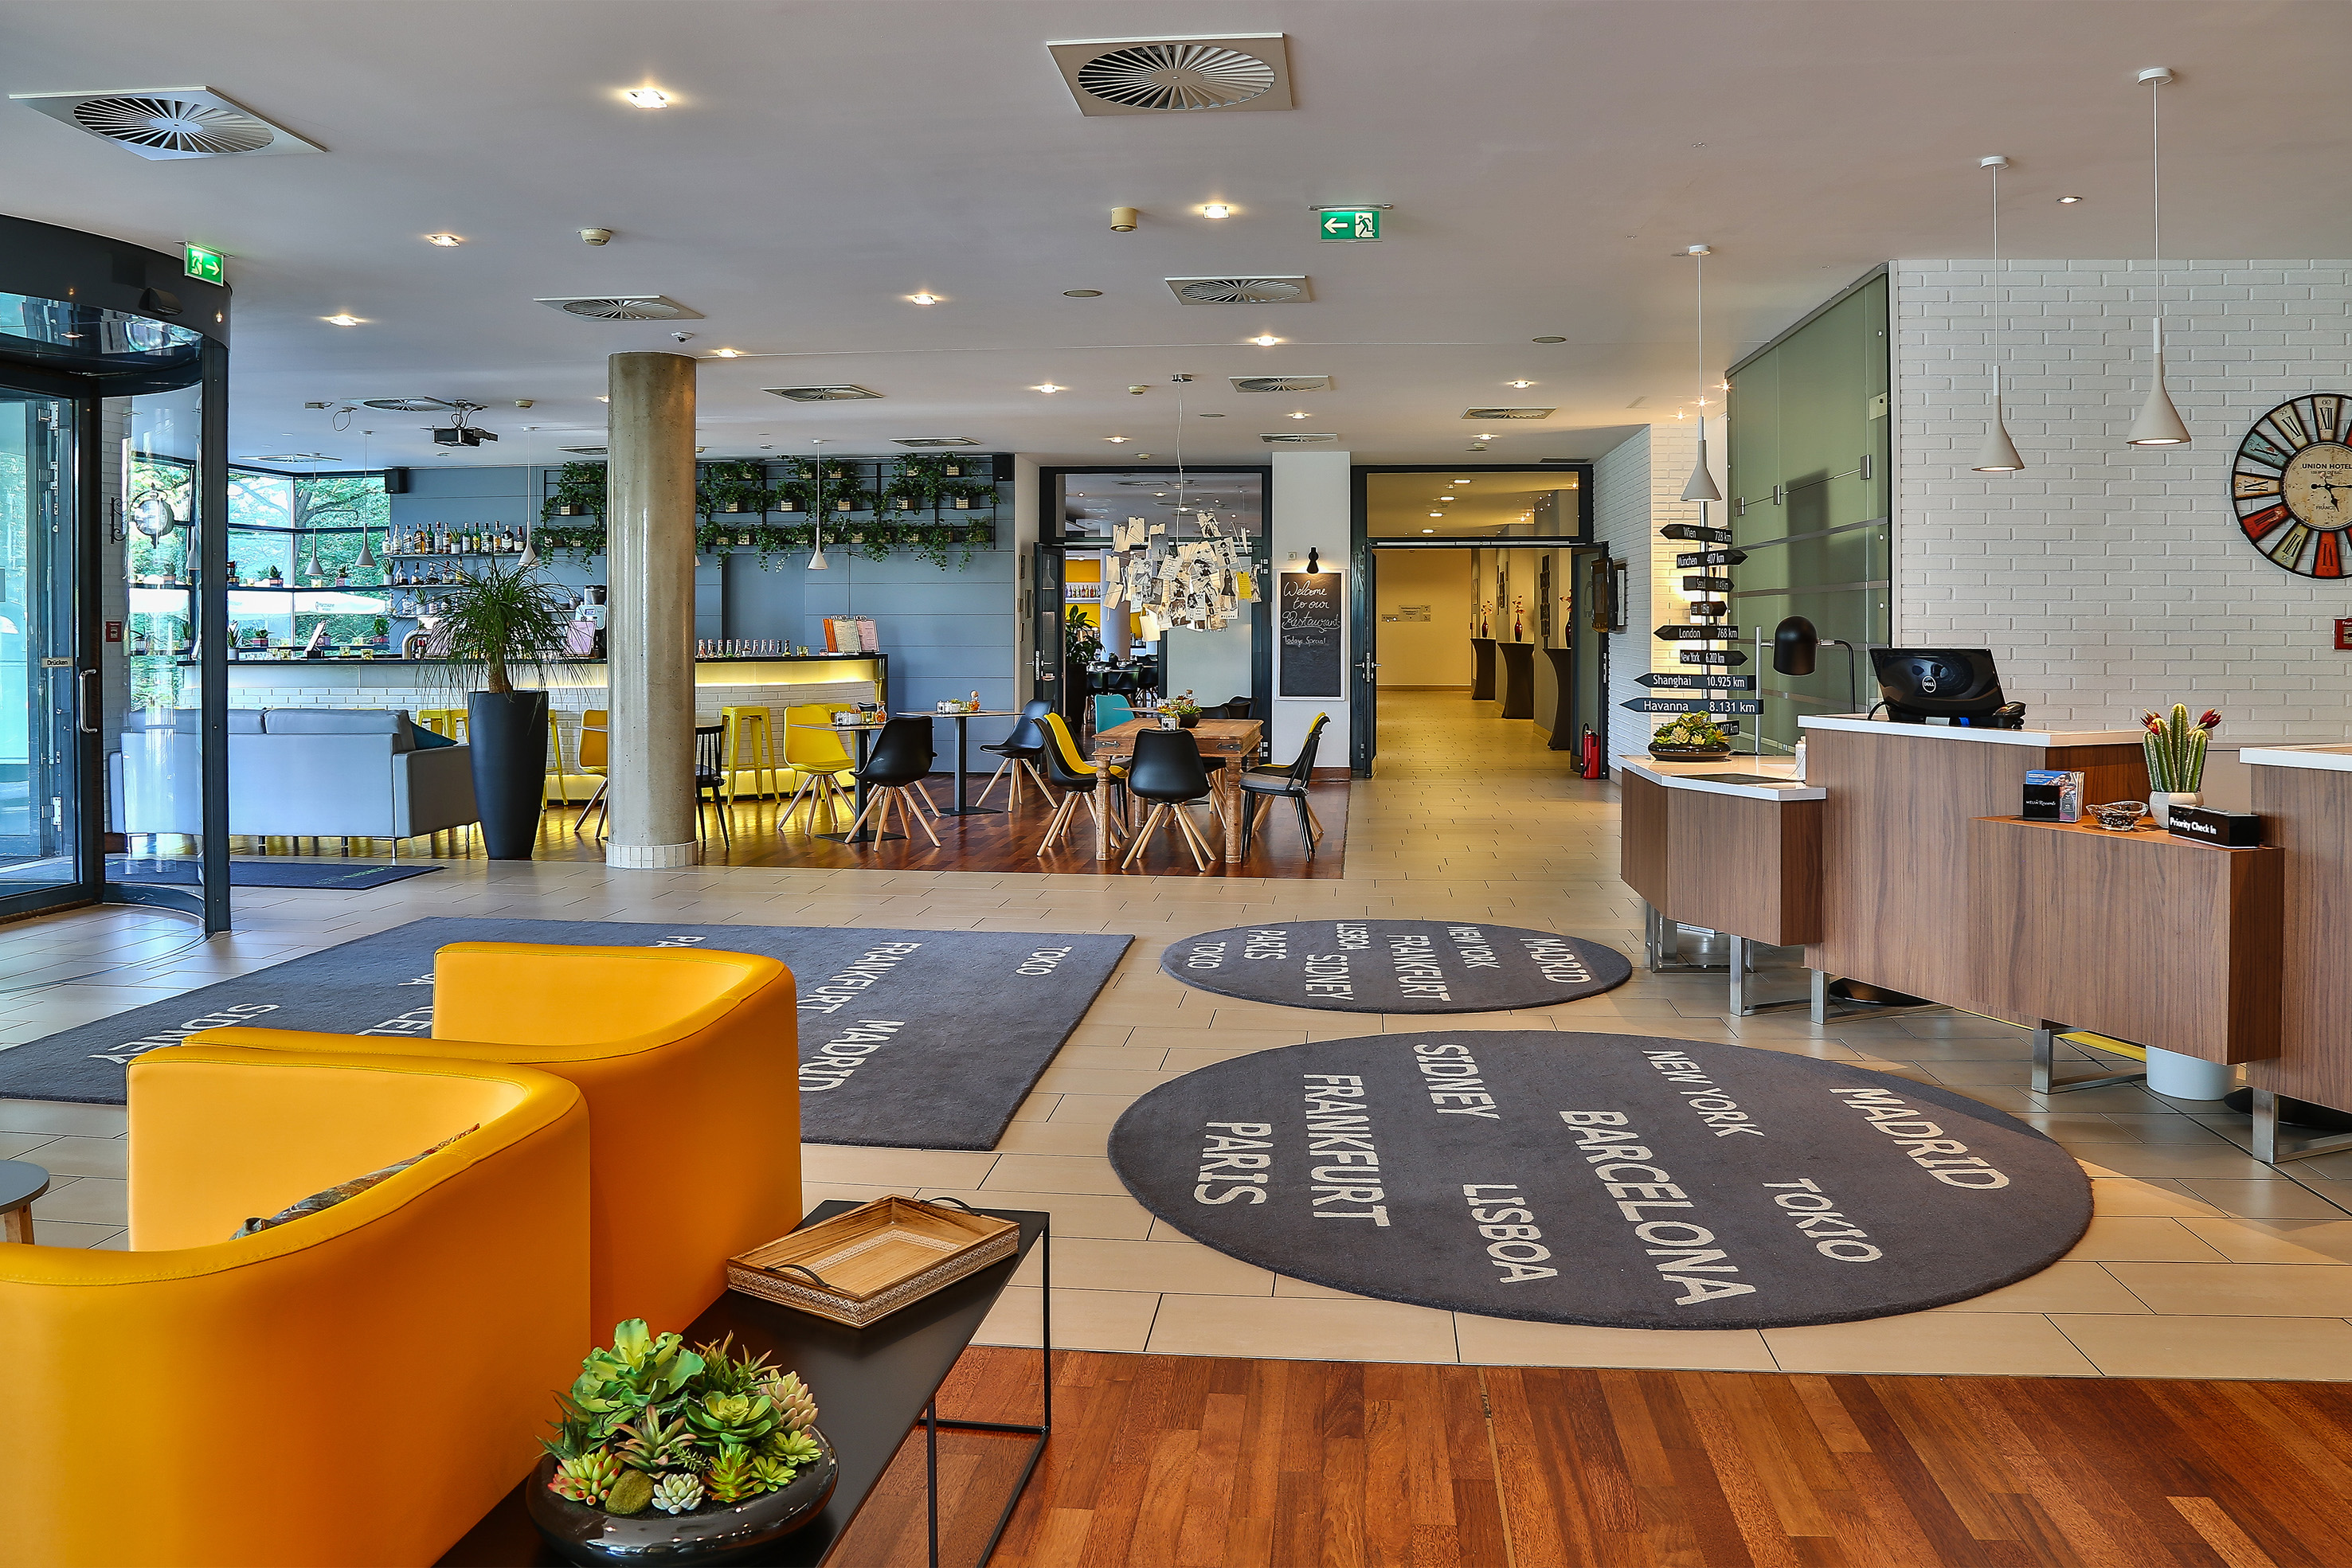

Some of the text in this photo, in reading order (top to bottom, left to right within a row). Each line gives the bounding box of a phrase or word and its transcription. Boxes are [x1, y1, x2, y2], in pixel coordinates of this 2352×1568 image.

[2319, 407, 2334, 430] XII
[1683, 526, 1732, 542] Wien 728 km
[1677, 553, 1724, 566] München 407 km
[1283, 580, 1328, 596] Welcome
[1293, 596, 1307, 610] to
[1282, 610, 1340, 630] Restaurant
[1679, 628, 1737, 638] London 768 km
[1681, 653, 1725, 663] New York 6.202 km
[1653, 675, 1745, 687] Shanghai 10.925 km
[1644, 700, 1755, 713] Havanna 8.131 km
[1730, 723, 1738, 733] km
[2170, 817, 2217, 835] Priority Check In
[1244, 929, 1287, 960] PARIS
[1336, 923, 1371, 950] LISBOA
[1446, 926, 1501, 969] NEW YORK
[1016, 946, 1073, 976] TOKIO
[1188, 941, 1227, 969] TOKIO
[1386, 934, 1452, 1002] FRANKFURT
[1519, 938, 1591, 983] MADRID
[796, 942, 922, 1014] FRANKFURT
[1305, 954, 1354, 1000] SIDNEY
[88, 1003, 280, 1065] SIDNEY
[799, 1020, 906, 1092] MADRID
[1413, 1044, 1501, 1120] SIDNEY
[1642, 1050, 1765, 1138] NEW YORK
[1303, 1073, 1391, 1227] FRANKFURT
[1829, 1088, 2010, 1190] MADRID
[1194, 1121, 1274, 1205] PARIS
[1560, 1110, 1757, 1306] BARCELONA
[1763, 1179, 1884, 1262] TOKIO
[1462, 1183, 1559, 1284] LISBOA
